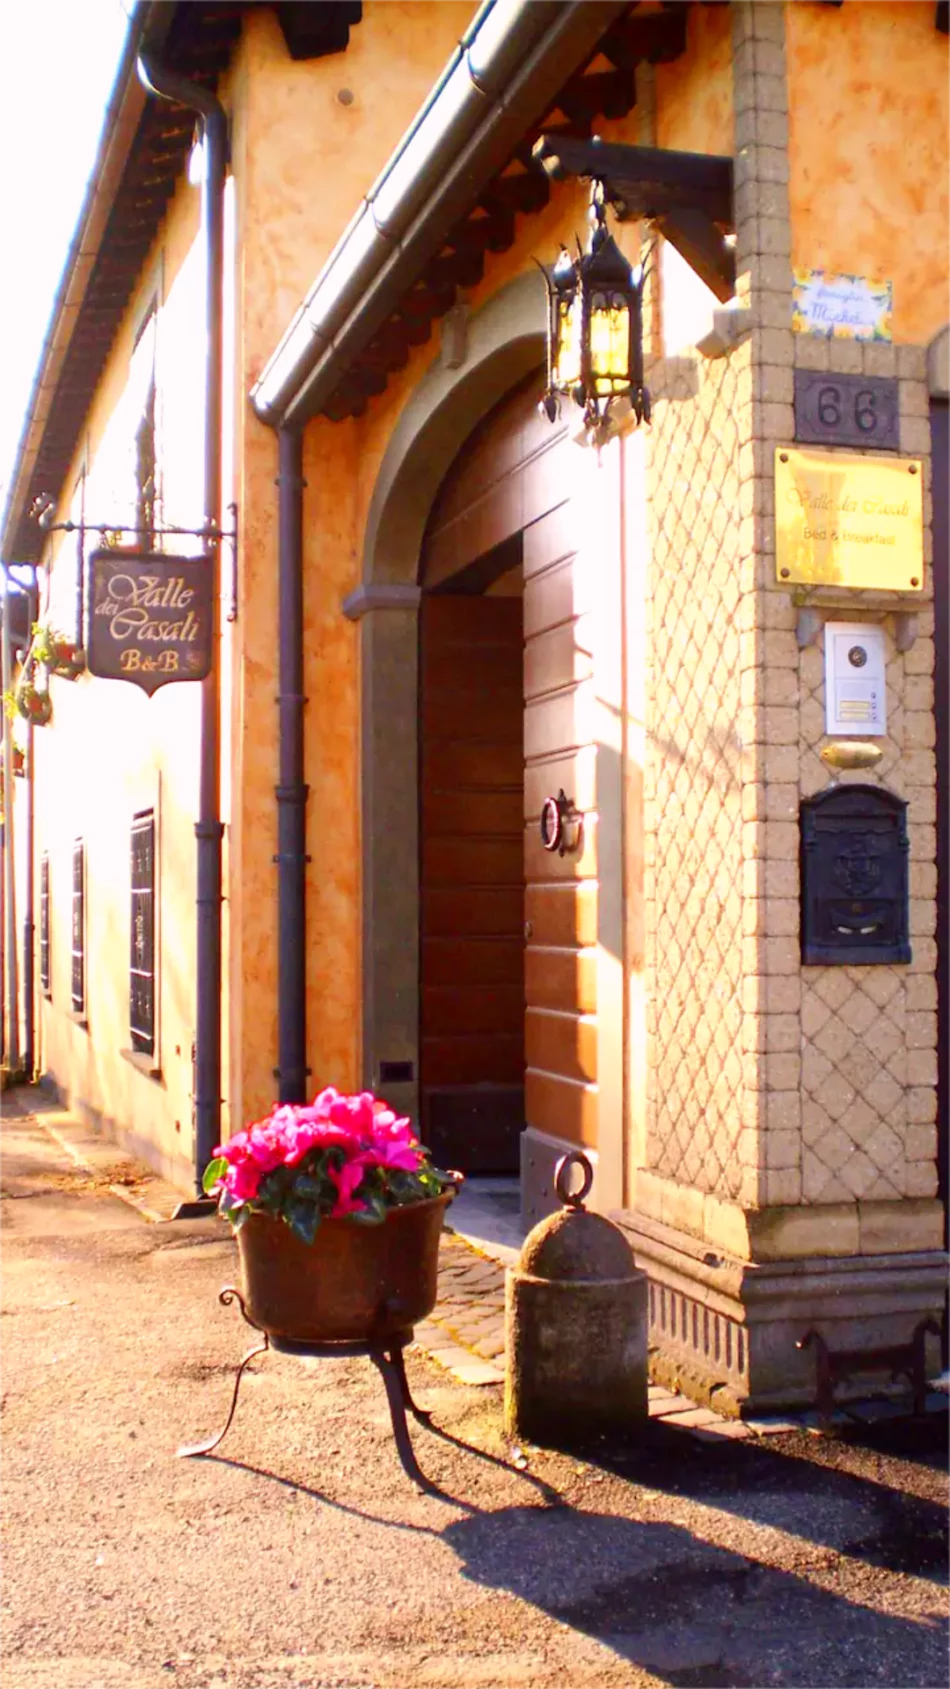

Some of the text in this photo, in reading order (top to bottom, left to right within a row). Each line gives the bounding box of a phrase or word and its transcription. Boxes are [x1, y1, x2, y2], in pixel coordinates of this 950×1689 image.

[819, 386, 877, 433] 66
[804, 527, 827, 541] Bed
[108, 574, 195, 608] Valle
[95, 597, 119, 615] dei
[110, 607, 199, 641] Casali
[120, 648, 179, 672] B&B
